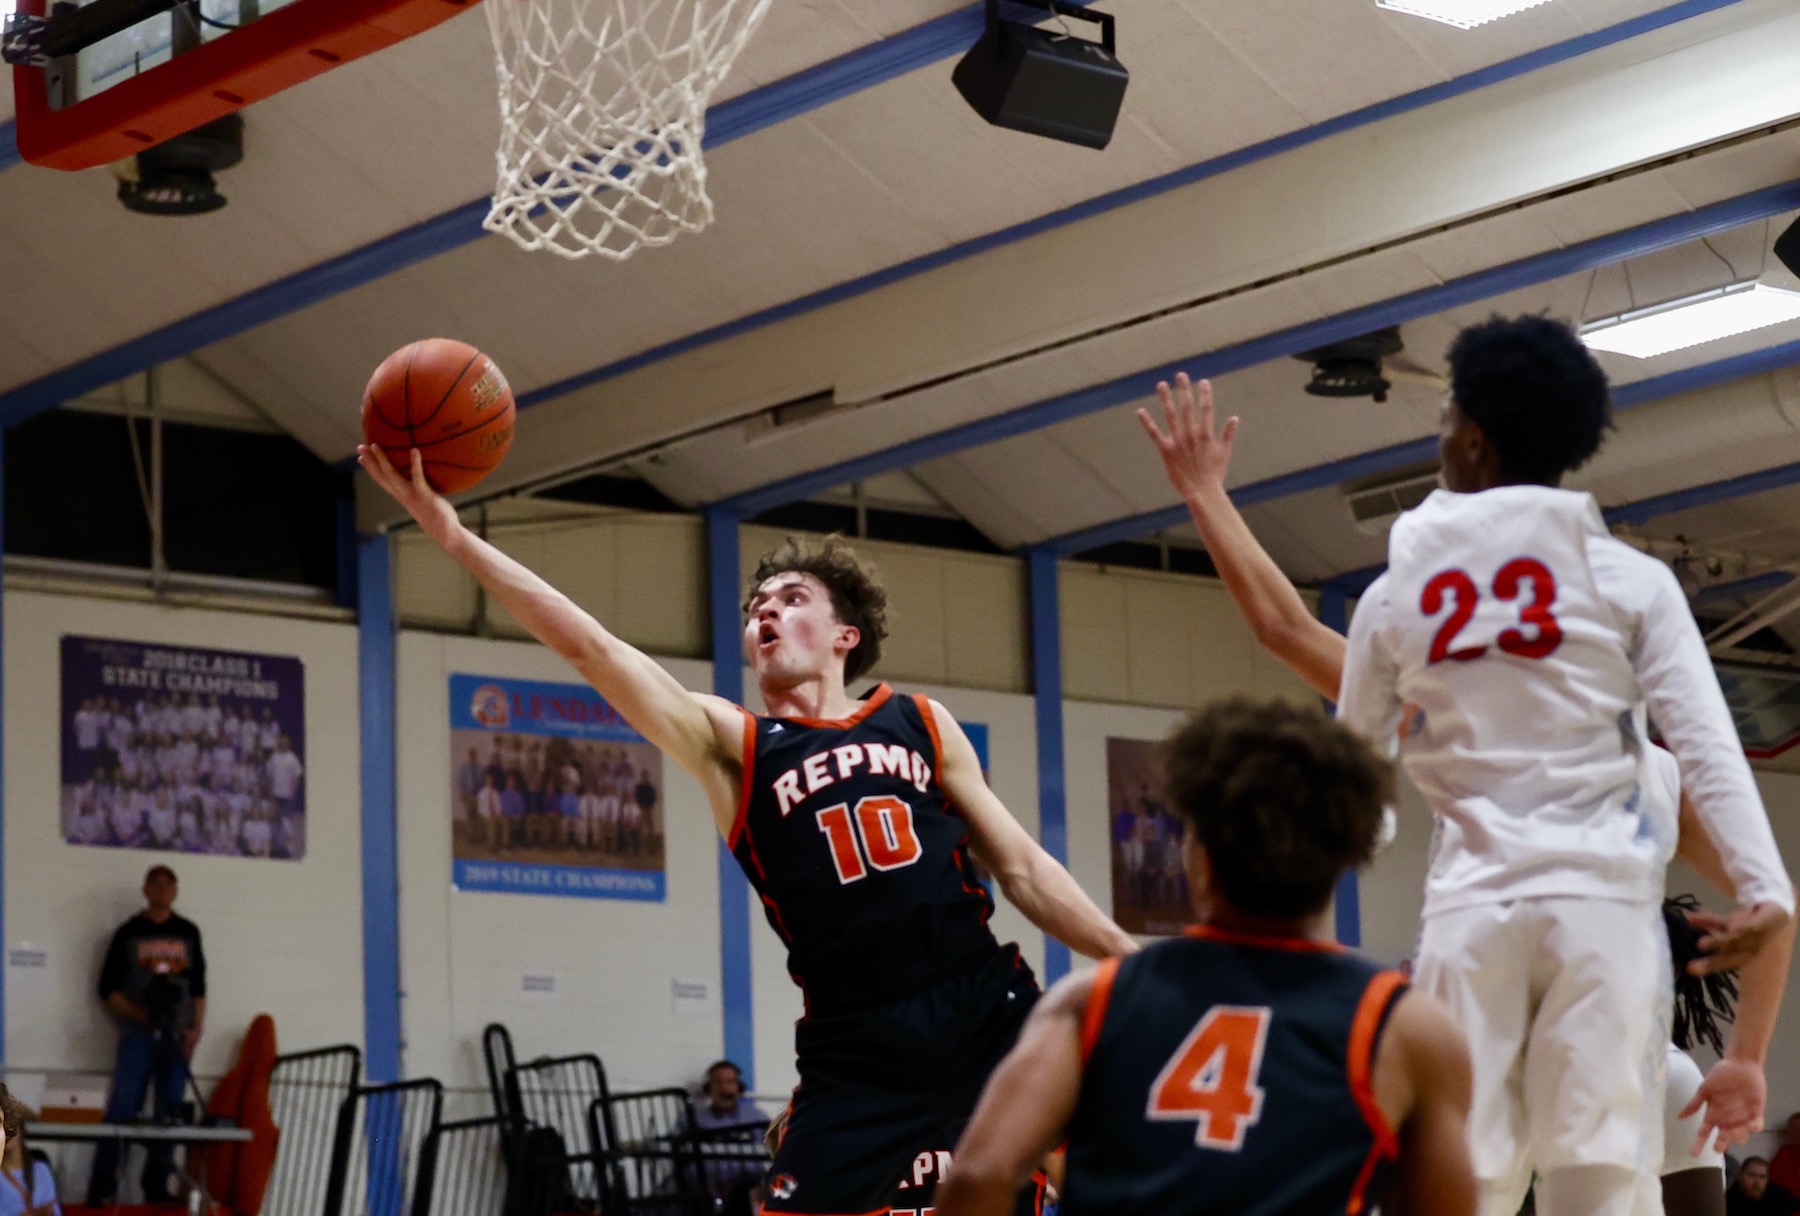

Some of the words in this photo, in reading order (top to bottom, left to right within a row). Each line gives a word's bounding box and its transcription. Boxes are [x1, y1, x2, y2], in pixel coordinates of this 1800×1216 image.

[1420, 555, 1564, 665] 23
[102, 664, 162, 690] STATE
[166, 671, 279, 700] CHAMPIONS
[815, 794, 923, 885] 10
[1146, 1004, 1273, 1153] 4
